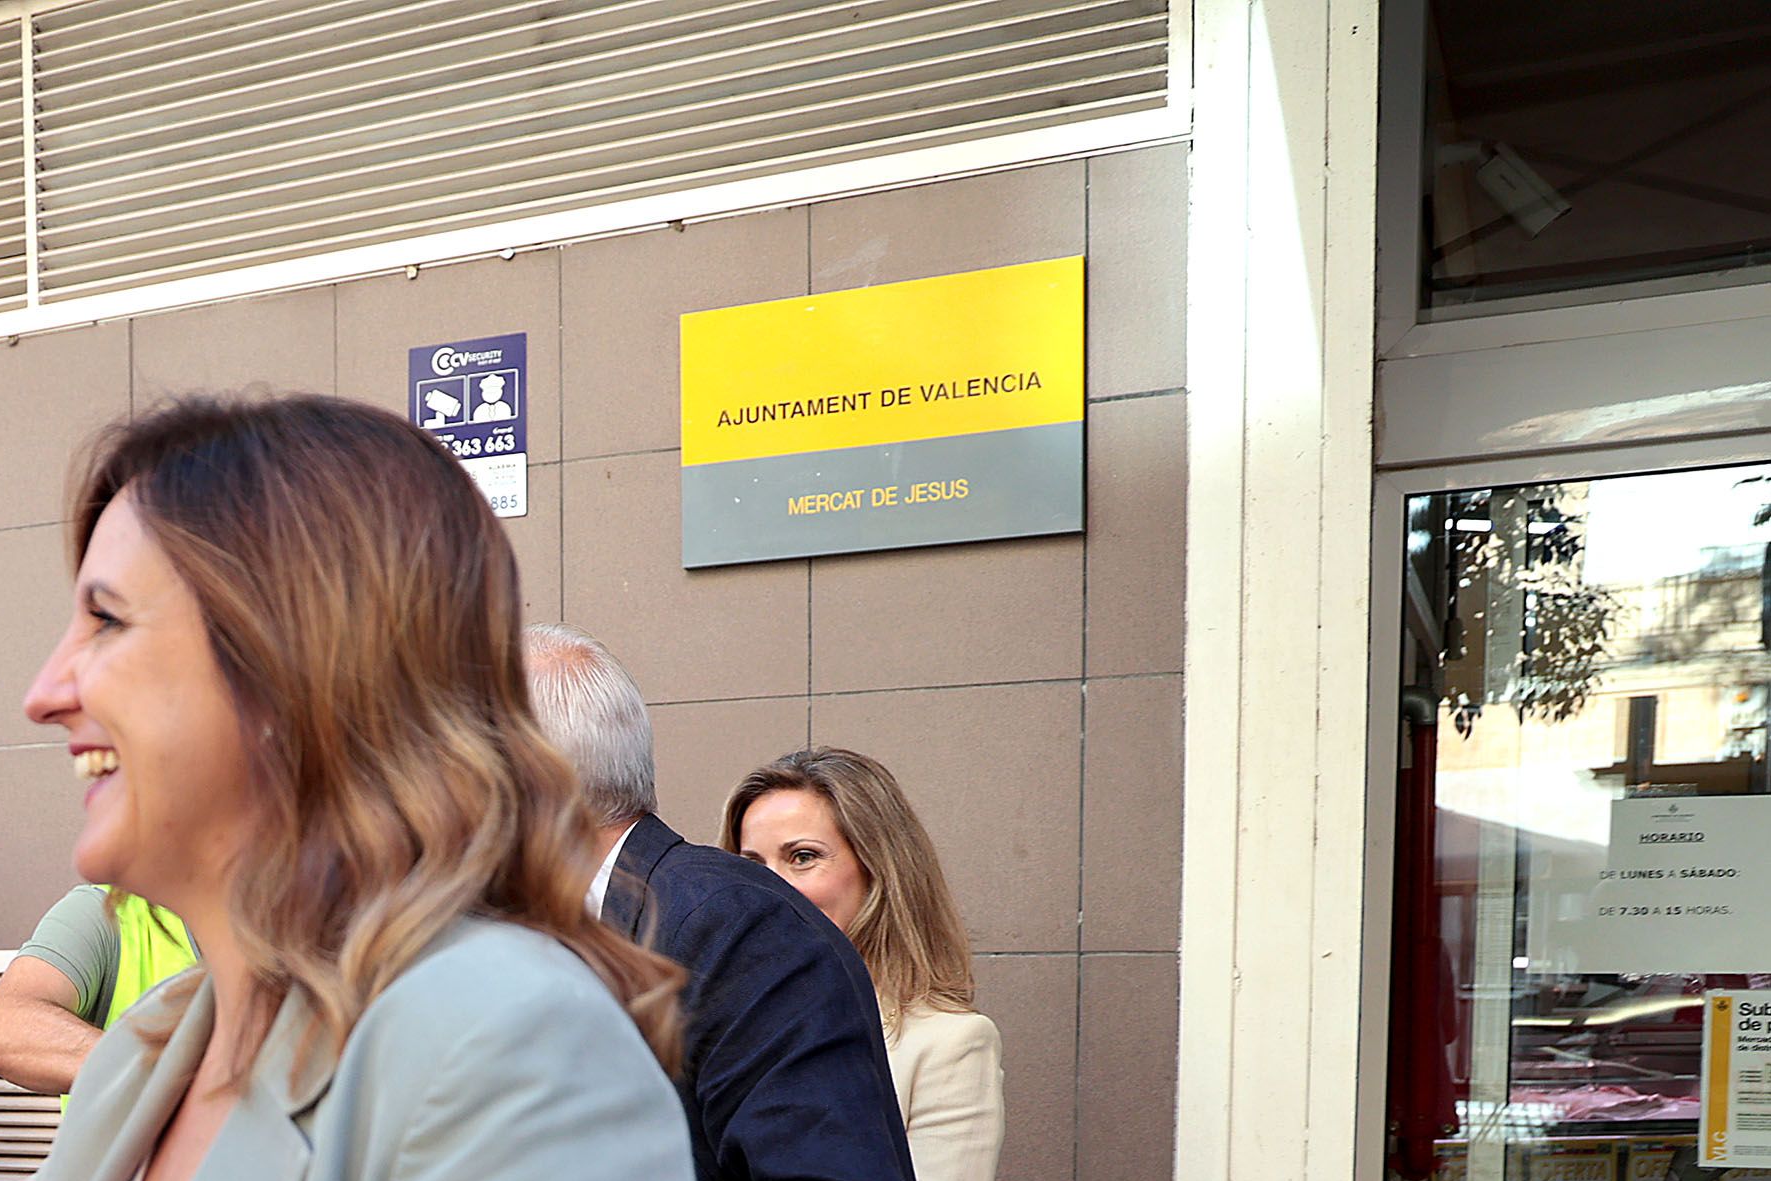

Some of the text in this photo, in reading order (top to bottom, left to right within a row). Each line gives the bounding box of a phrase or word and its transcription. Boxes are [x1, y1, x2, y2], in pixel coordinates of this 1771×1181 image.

[717, 371, 1042, 428] AJUNTAMENT DE VALENCIA
[788, 478, 969, 516] MERCAT DE JESUS
[1639, 832, 1705, 844] HORARIO
[1599, 866, 1741, 880] DE LUNES A SÁBADO:
[1598, 907, 1616, 917] DE
[1619, 906, 1649, 916] 7.30
[1652, 906, 1662, 916] A
[1665, 906, 1682, 916] 15
[1738, 1018, 1761, 1031] de
